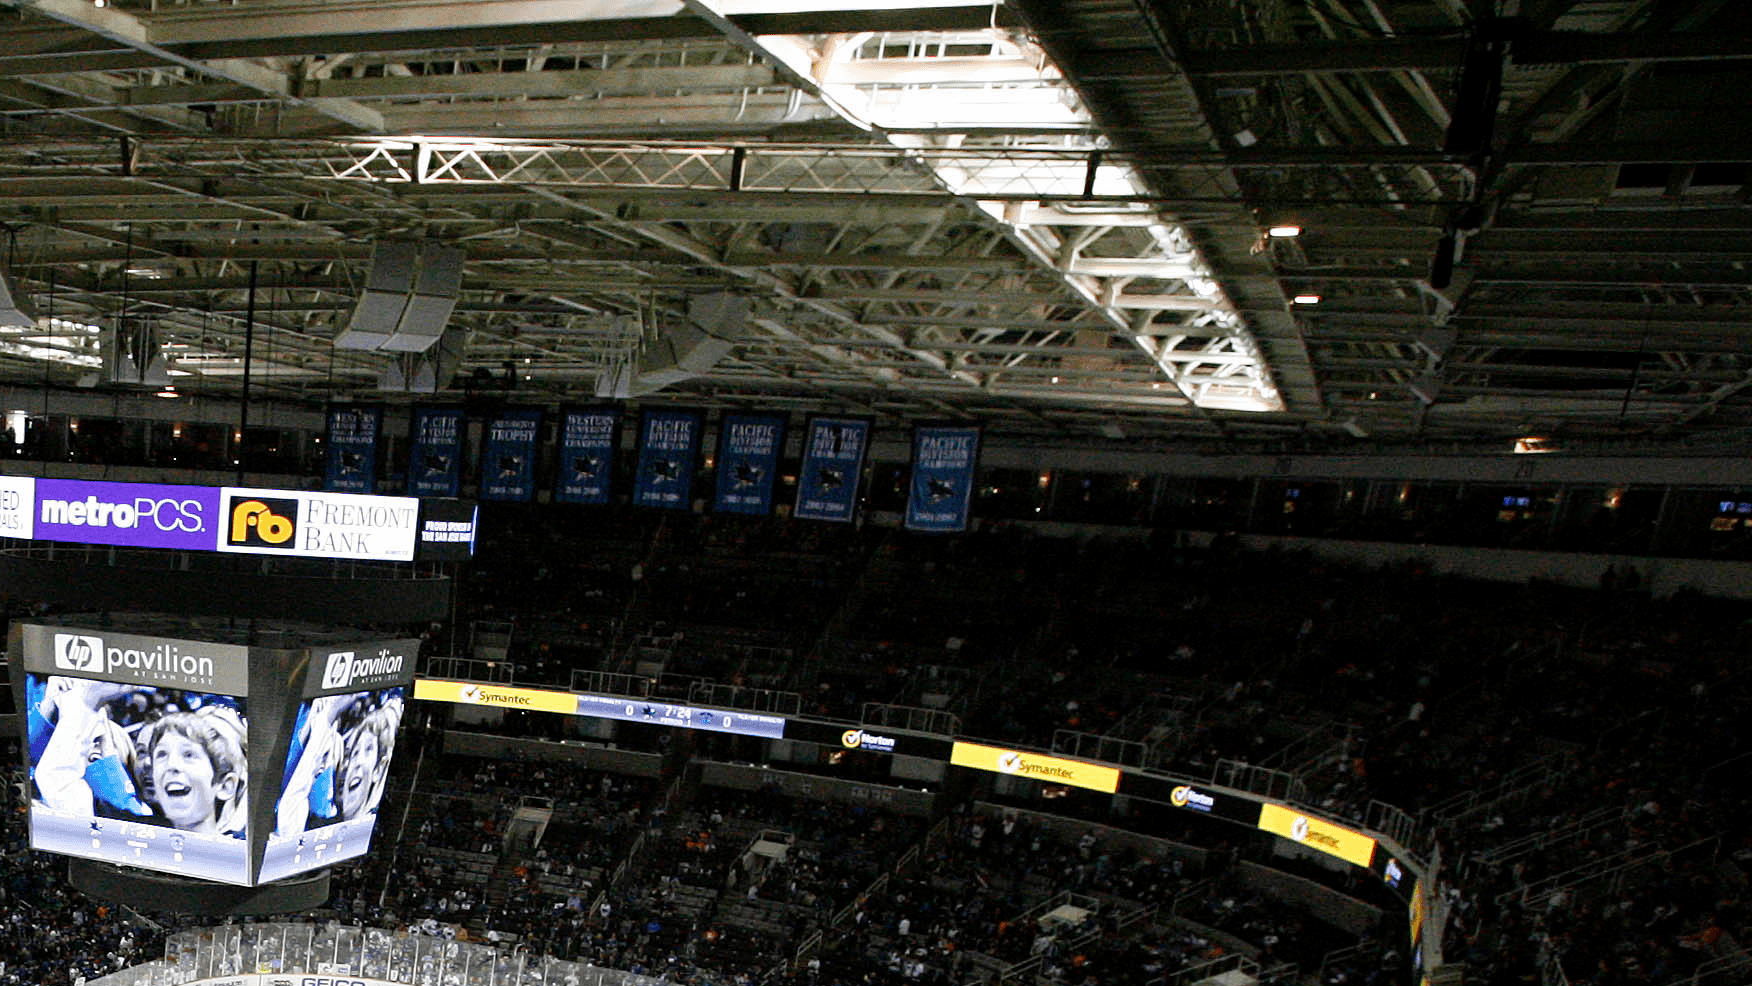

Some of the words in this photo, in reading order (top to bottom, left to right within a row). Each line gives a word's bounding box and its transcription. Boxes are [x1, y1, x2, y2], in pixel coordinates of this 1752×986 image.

[490, 429, 536, 441] TROPHY
[731, 424, 776, 436] PACIFIC
[815, 426, 860, 440] PACFIC
[305, 499, 415, 529] FREMONT
[304, 526, 372, 554] BANK
[107, 644, 213, 677] pavilion
[349, 648, 403, 686] pavilion
[479, 690, 530, 705] Symantec
[665, 704, 692, 719] 7:24
[861, 733, 895, 746] Norton
[1019, 759, 1073, 779] Symantec
